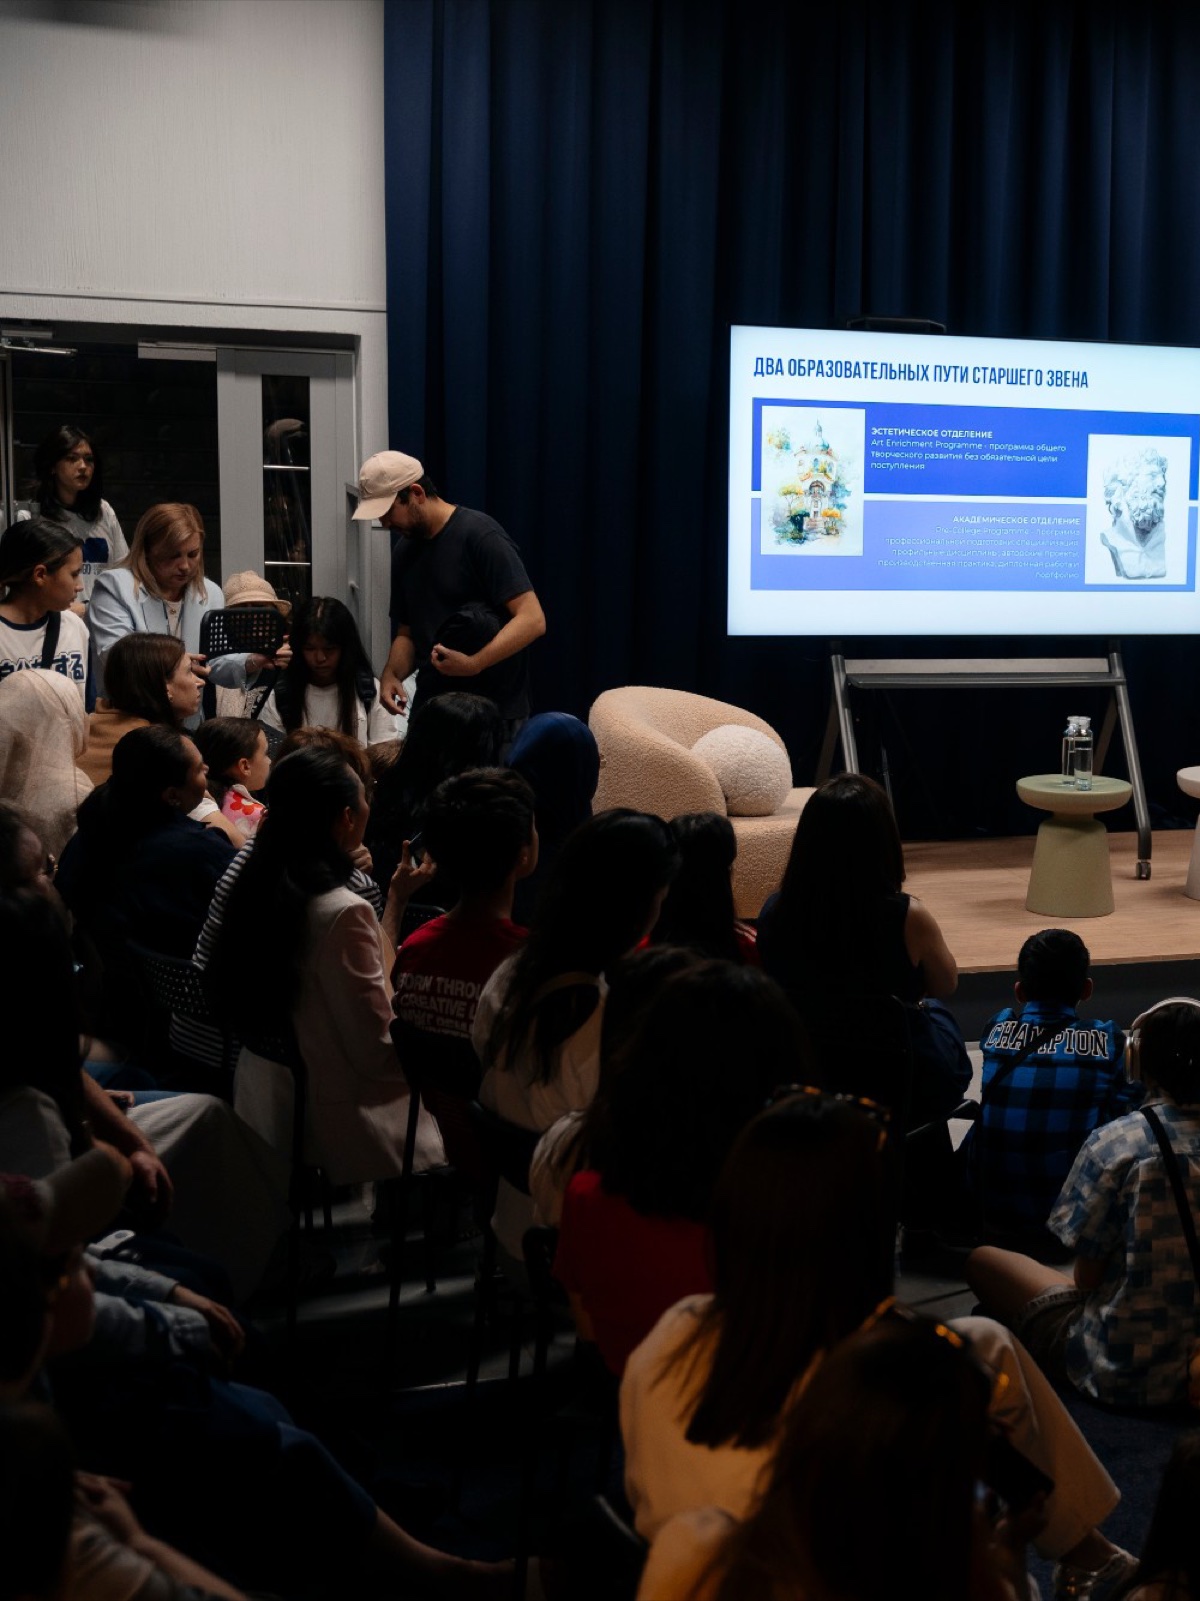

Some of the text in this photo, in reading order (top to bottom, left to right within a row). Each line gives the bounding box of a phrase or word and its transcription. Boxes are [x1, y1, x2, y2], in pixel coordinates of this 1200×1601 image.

[753, 357, 1089, 388] ДВА ОБРАЗОВАТЕЛЬНЫХ ПУТИ СТАРШЕГО ЗВЕНА
[871, 427, 993, 438] ЭСТЕТИЧЕСКОЕ ОТДЕЛЕНИЕ
[871, 438, 884, 446] Art
[886, 438, 933, 448] Enrichment
[935, 440, 983, 450] Programme
[989, 442, 1034, 451] программа
[1036, 443, 1067, 452] общего
[871, 451, 1058, 463] творческого развития без обязательной цели
[870, 462, 925, 471] поступления
[952, 515, 1081, 525] АКАДЕМИЧЕСКОЕ ОТДЕЛЕНИЕ
[984, 527, 1029, 536] Programme
[1036, 528, 1081, 537] программа
[400, 993, 468, 1018] CREATIVE
